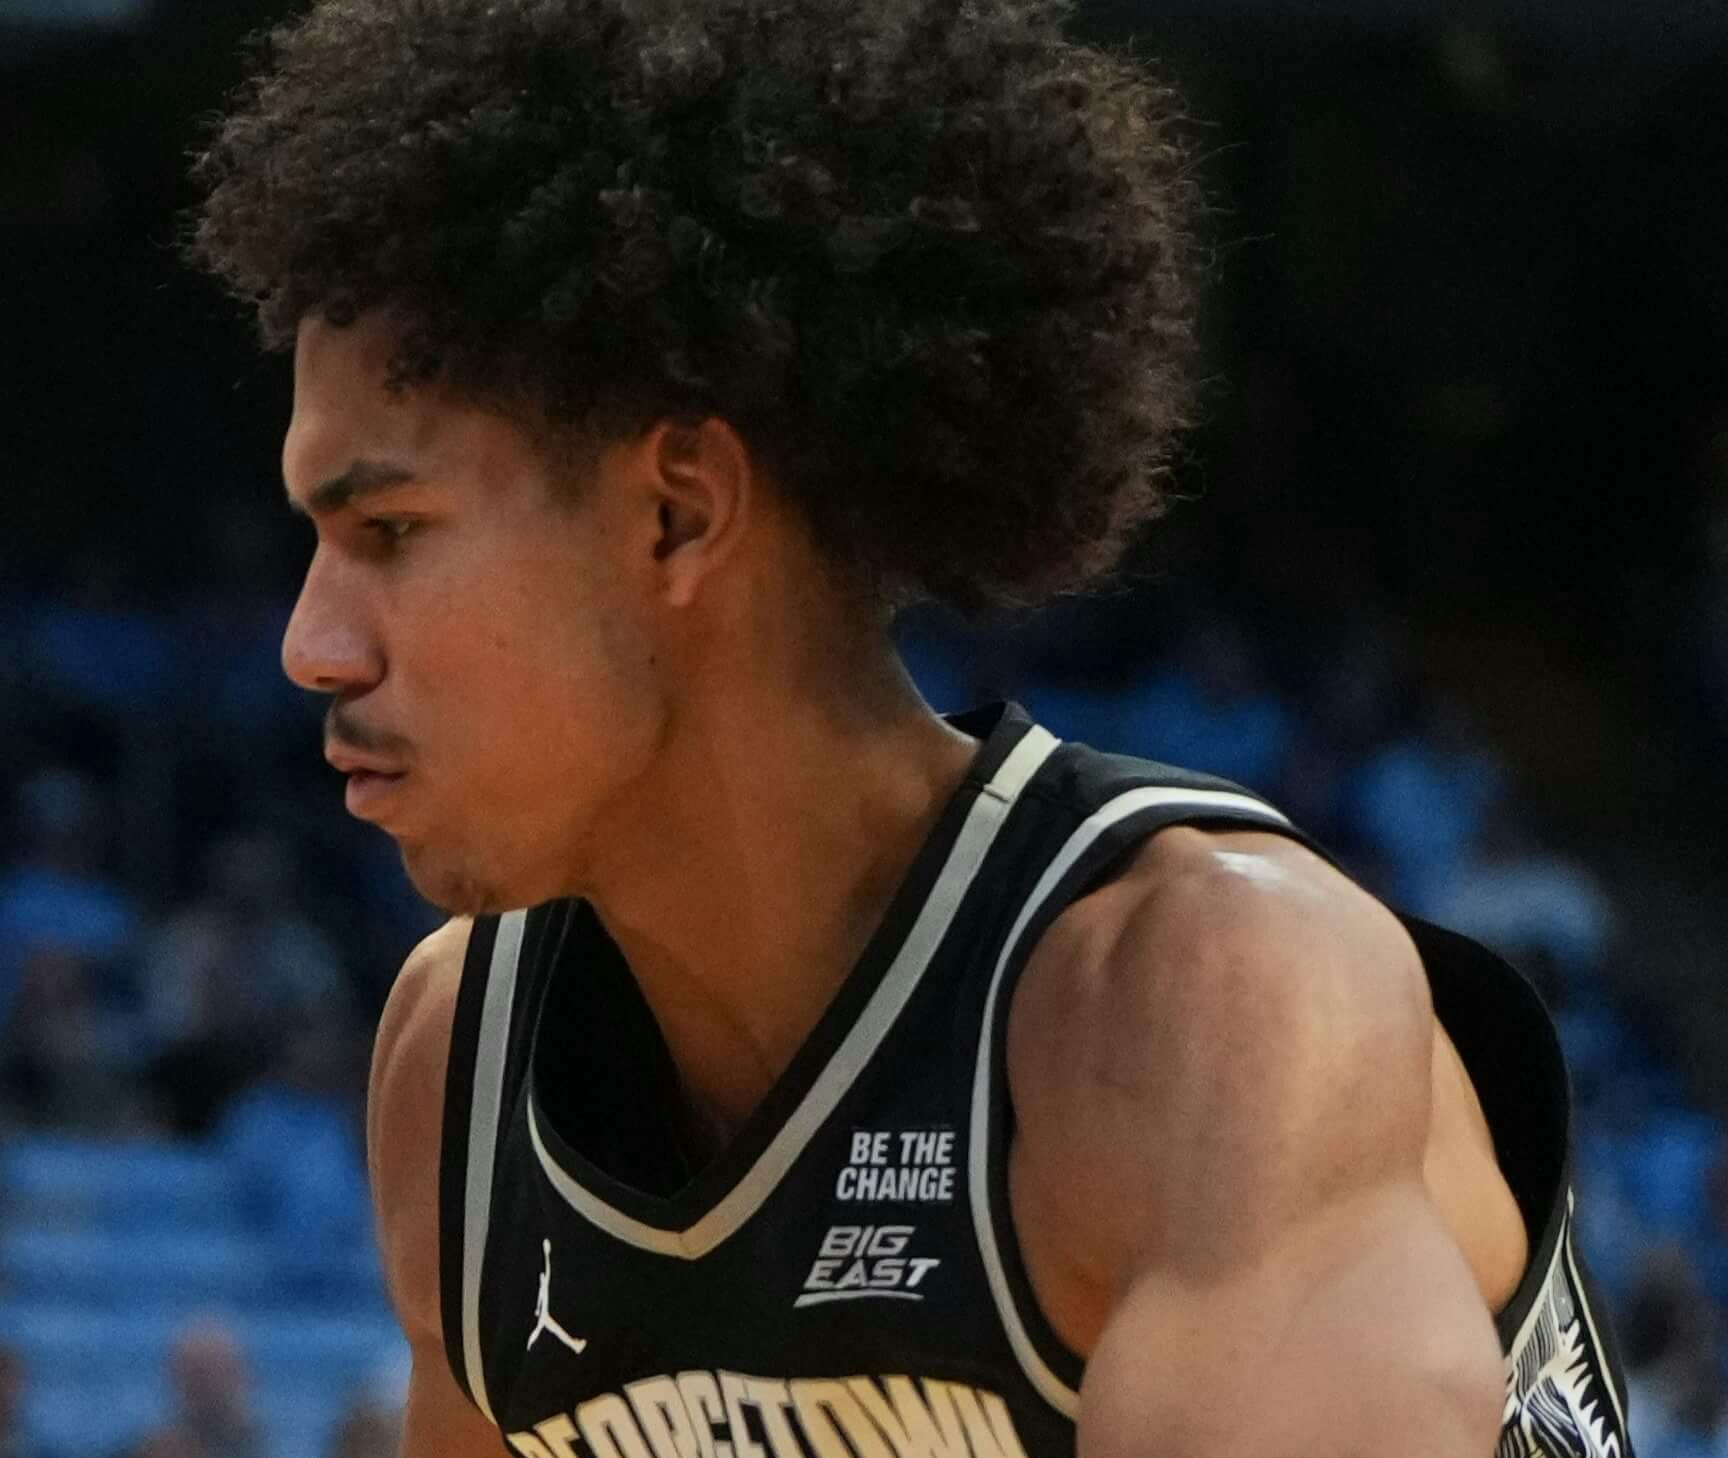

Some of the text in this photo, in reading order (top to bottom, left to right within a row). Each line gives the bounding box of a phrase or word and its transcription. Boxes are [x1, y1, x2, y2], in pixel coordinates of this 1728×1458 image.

[850, 1132, 955, 1165] BE THE
[836, 1167, 956, 1200] CHANGE
[818, 1225, 916, 1257] BIG
[803, 1257, 941, 1289] EAST
